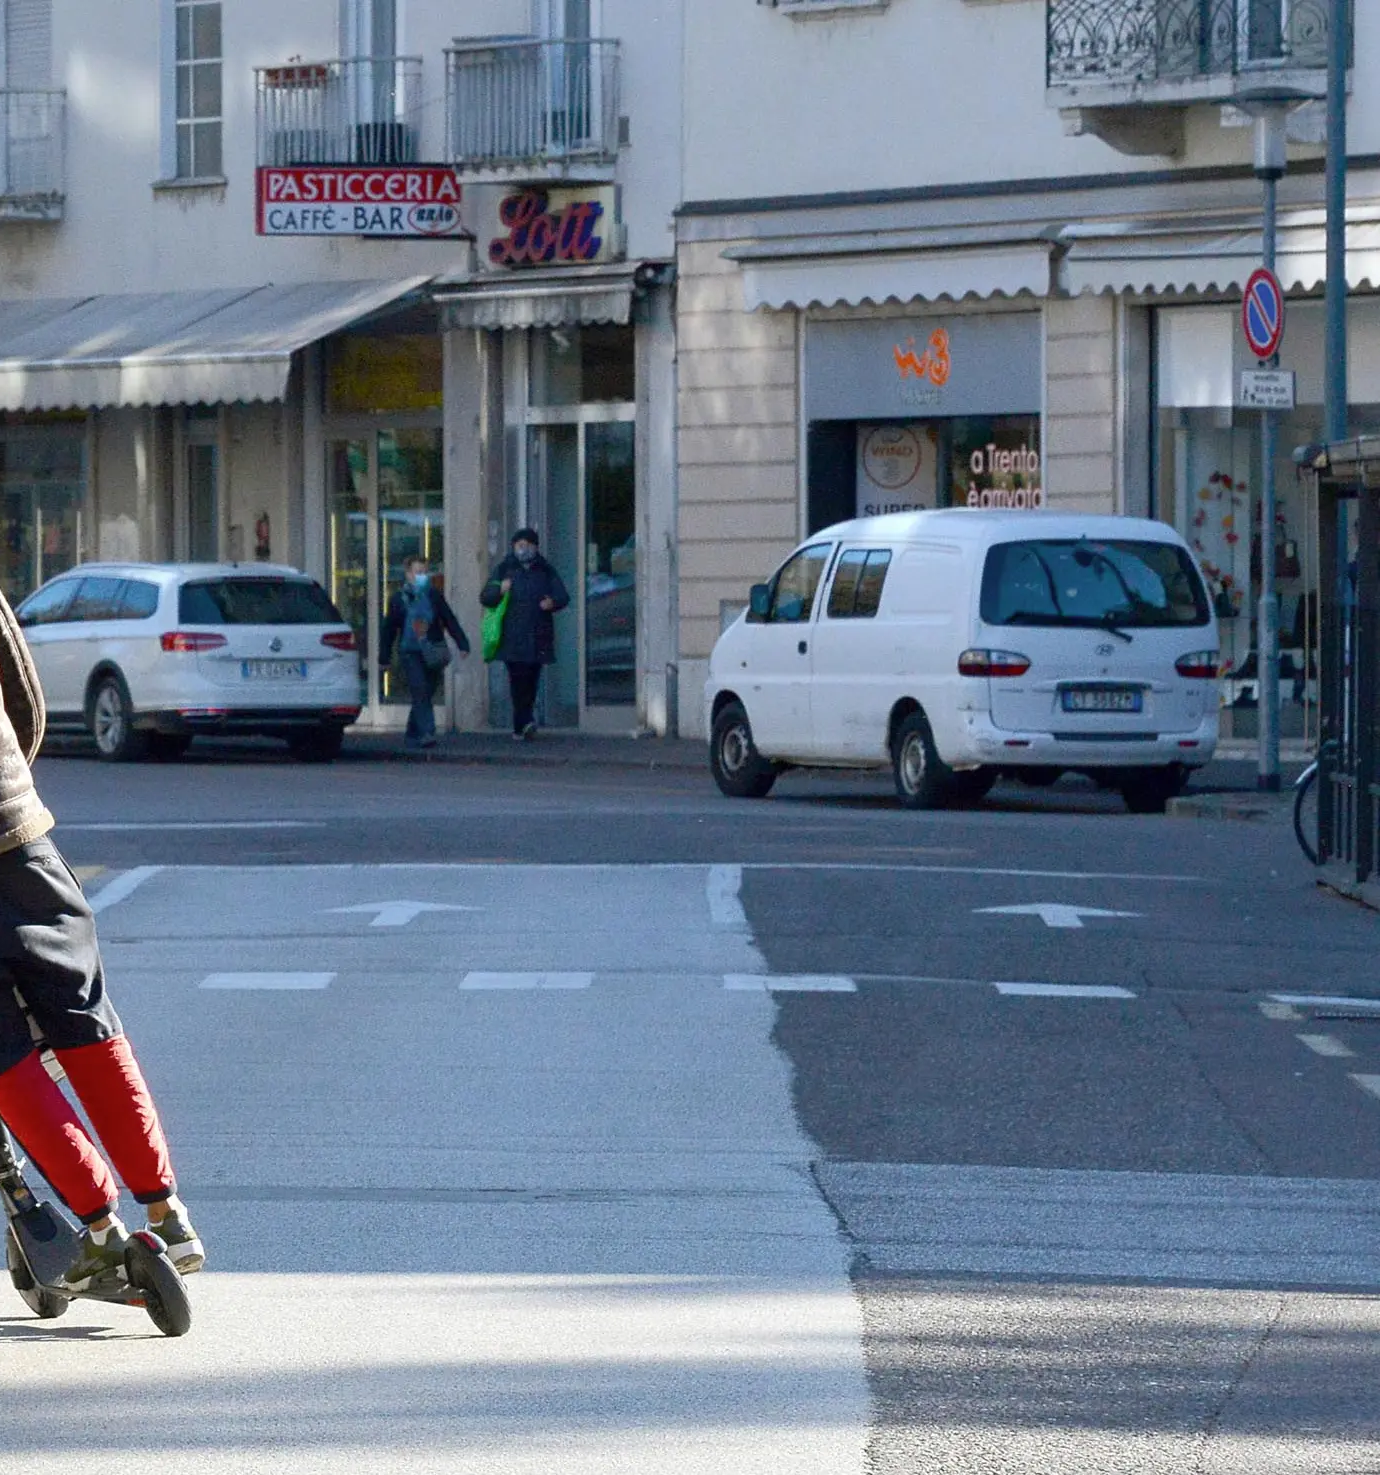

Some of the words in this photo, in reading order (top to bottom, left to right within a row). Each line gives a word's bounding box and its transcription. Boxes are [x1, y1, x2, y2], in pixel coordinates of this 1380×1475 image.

[269, 173, 458, 200] PASTICCERIA
[353, 206, 405, 231] BAR
[970, 450, 984, 475] a
[985, 443, 1039, 474] Trento
[980, 481, 1043, 510] arrivato
